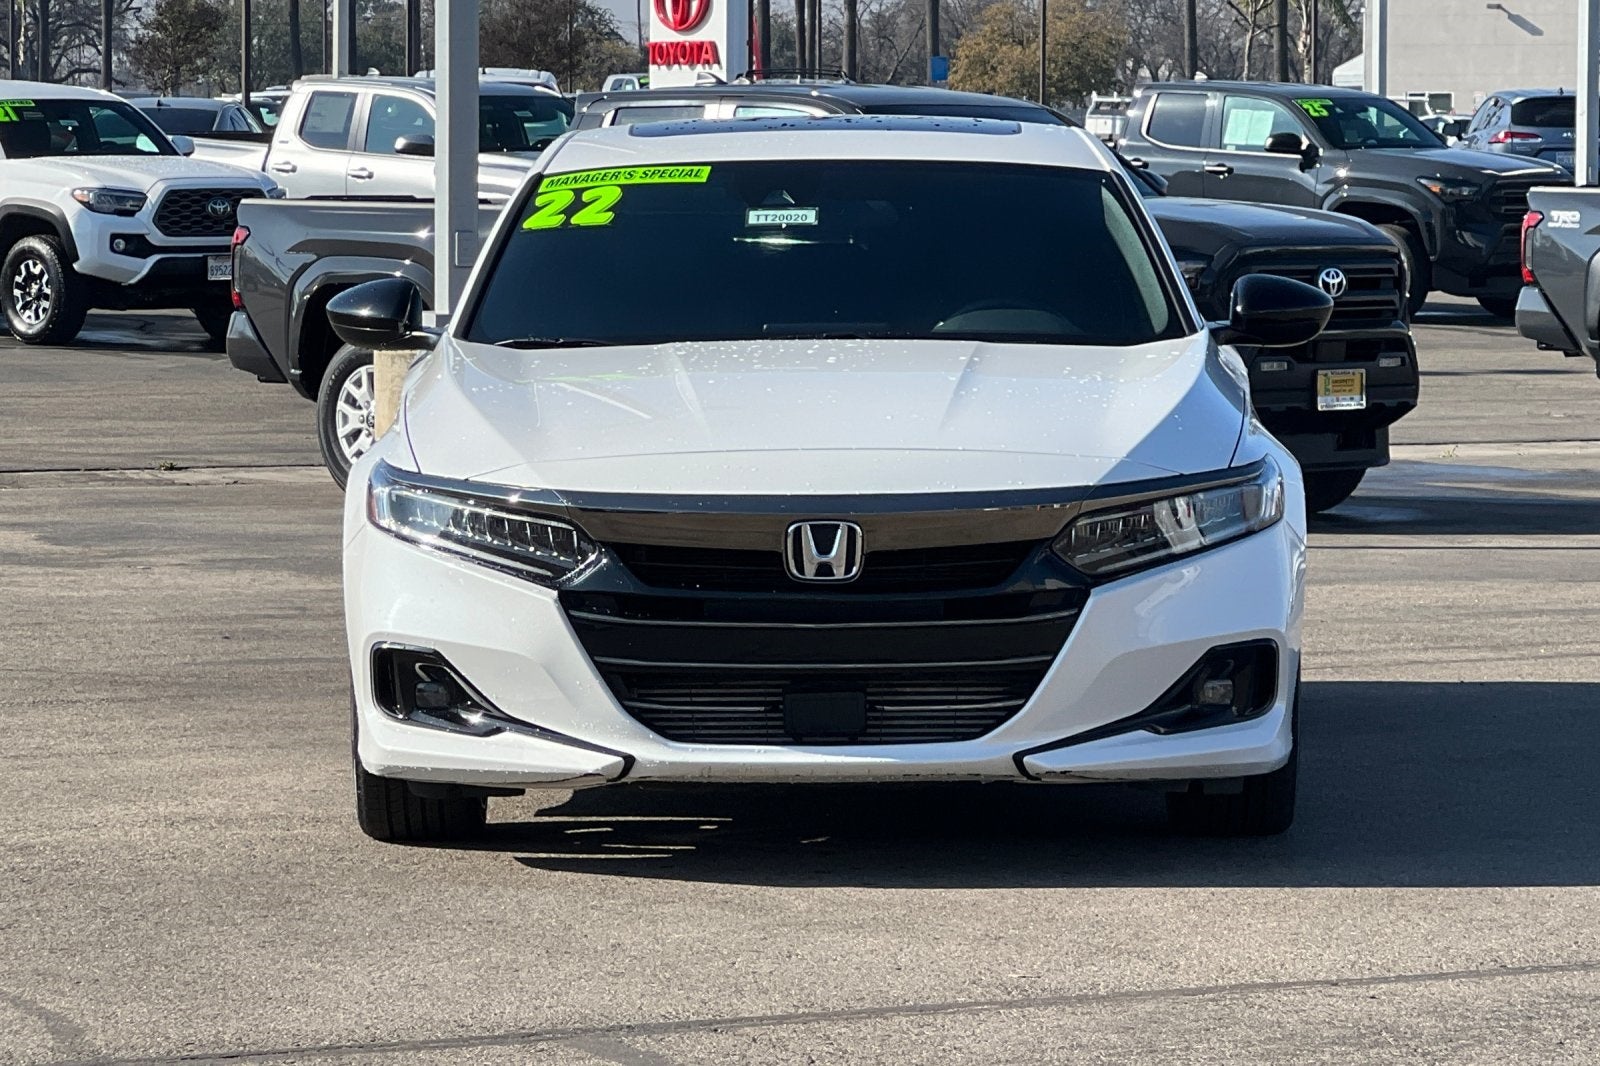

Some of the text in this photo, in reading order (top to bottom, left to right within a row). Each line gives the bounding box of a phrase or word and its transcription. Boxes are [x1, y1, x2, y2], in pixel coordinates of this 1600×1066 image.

[647, 40, 718, 66] TOYOTA
[545, 168, 704, 189] MANAGER'S SPECIAL
[522, 185, 623, 230] 22
[755, 213, 808, 222] TT20020
